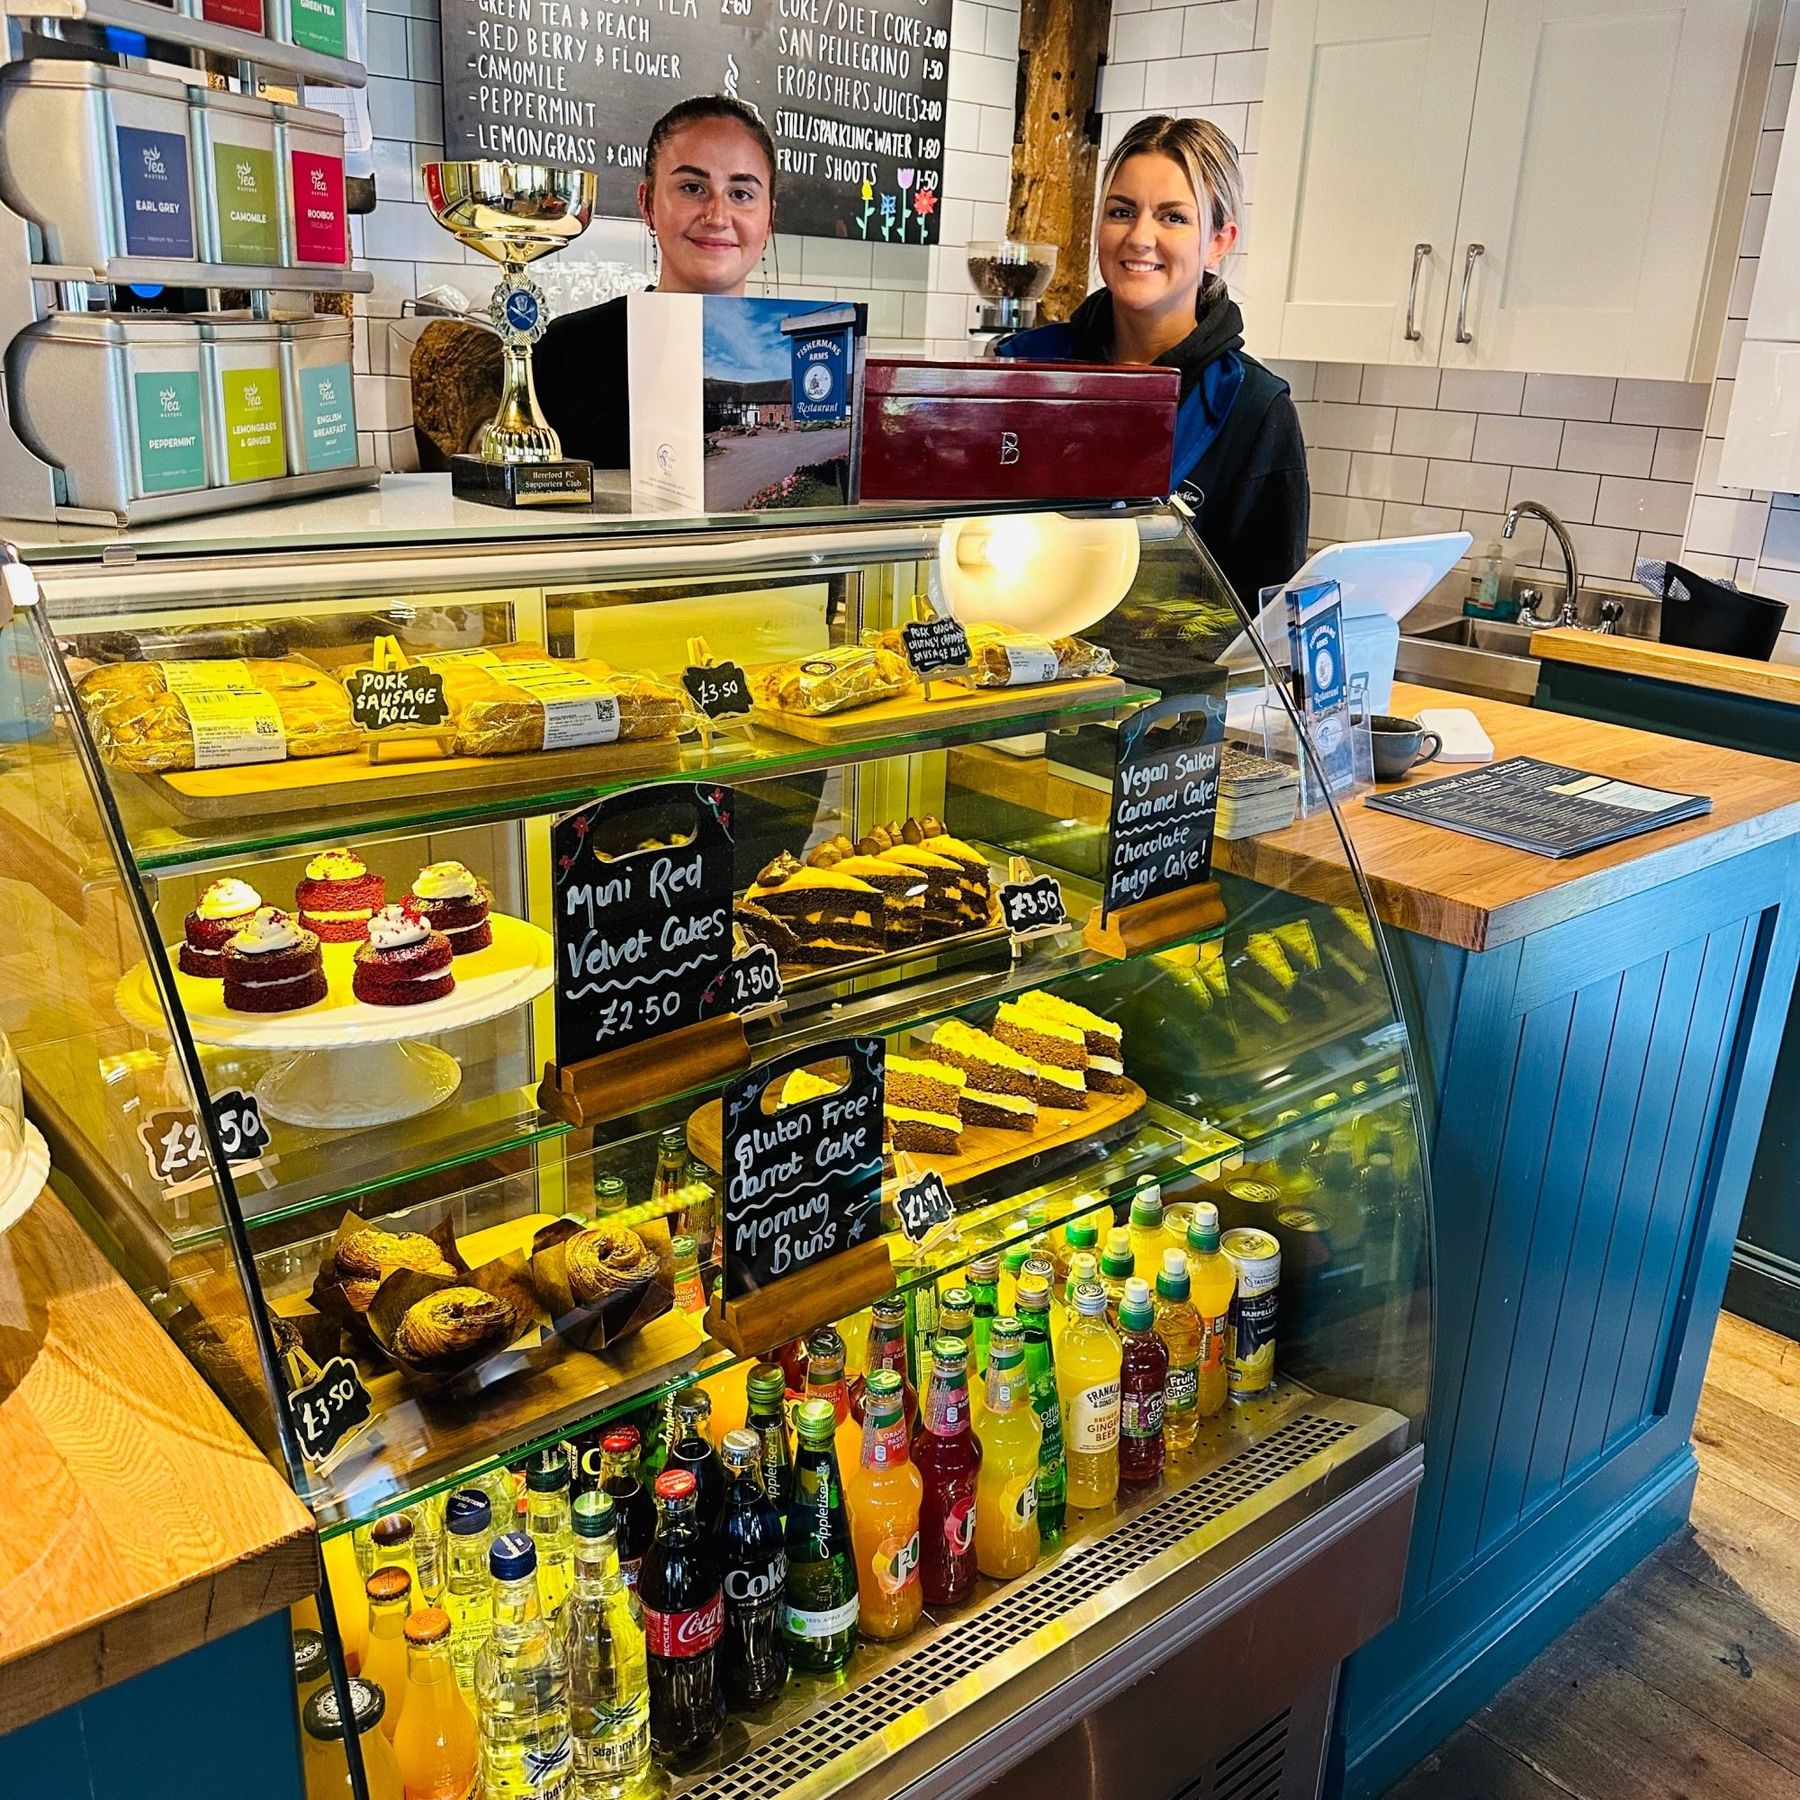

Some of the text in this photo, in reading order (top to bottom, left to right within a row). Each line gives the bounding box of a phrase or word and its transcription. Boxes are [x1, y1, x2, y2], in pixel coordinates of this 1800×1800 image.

[300, 0, 336, 16] GREEN TEA
[540, 2, 573, 28] TEA
[597, 10, 650, 43] PEACH
[884, 12, 922, 48] COKE
[526, 27, 588, 63] BERRY
[612, 45, 682, 79] FLOWER
[778, 26, 814, 60] SAN
[818, 34, 911, 79] PELLEGRINO
[776, 65, 871, 112] FROBISHERS
[873, 86, 919, 123] JUICES
[874, 129, 913, 159] WATER
[144, 156, 166, 174] Tea
[776, 148, 818, 176] FRUIT
[825, 156, 878, 186] SHOOTS
[237, 170, 255, 187] Tea
[312, 176, 327, 191] Tea
[136, 200, 180, 214] EARL GREY
[307, 209, 335, 221] ROOIBOS
[230, 211, 267, 224] CAMOMILE
[796, 339, 842, 359] FISHERMANS
[809, 351, 829, 361] ARMS
[160, 397, 181, 412] Tea
[245, 392, 261, 406] Tea
[320, 388, 335, 401] Tea
[317, 412, 342, 425] ENGLISH
[796, 401, 838, 418] Restaurant
[232, 422, 277, 435] LEMONGRASS
[313, 423, 348, 438] BREAKFAST
[148, 436, 196, 450] PEPPERMINT
[247, 435, 272, 447] GINGER
[525, 479, 582, 489] Supporters Club
[362, 672, 409, 693] PORK
[356, 687, 437, 711] SAUSAGE
[377, 705, 420, 725] ROLL
[1120, 762, 1169, 798] Vegan
[1117, 774, 1219, 825] Caramel Cake!
[1114, 826, 1190, 867] Chocolate
[1111, 839, 1206, 900] Fudge Cake!
[650, 854, 703, 908] Red
[567, 908, 727, 978] Velvet Cakes
[595, 991, 681, 1042] £2.50
[734, 1086, 878, 1171] Gluten Free!
[729, 1127, 867, 1203] Carrot Cake
[735, 1192, 830, 1257] Morning
[770, 1222, 837, 1275] Buns
[1170, 1371, 1194, 1388] Fruit
[1166, 1382, 1197, 1399] Shoot
[1095, 1430, 1117, 1442] BEER
[810, 1480, 832, 1559] Appletiser
[663, 1613, 671, 1657] RECYCLE ME
